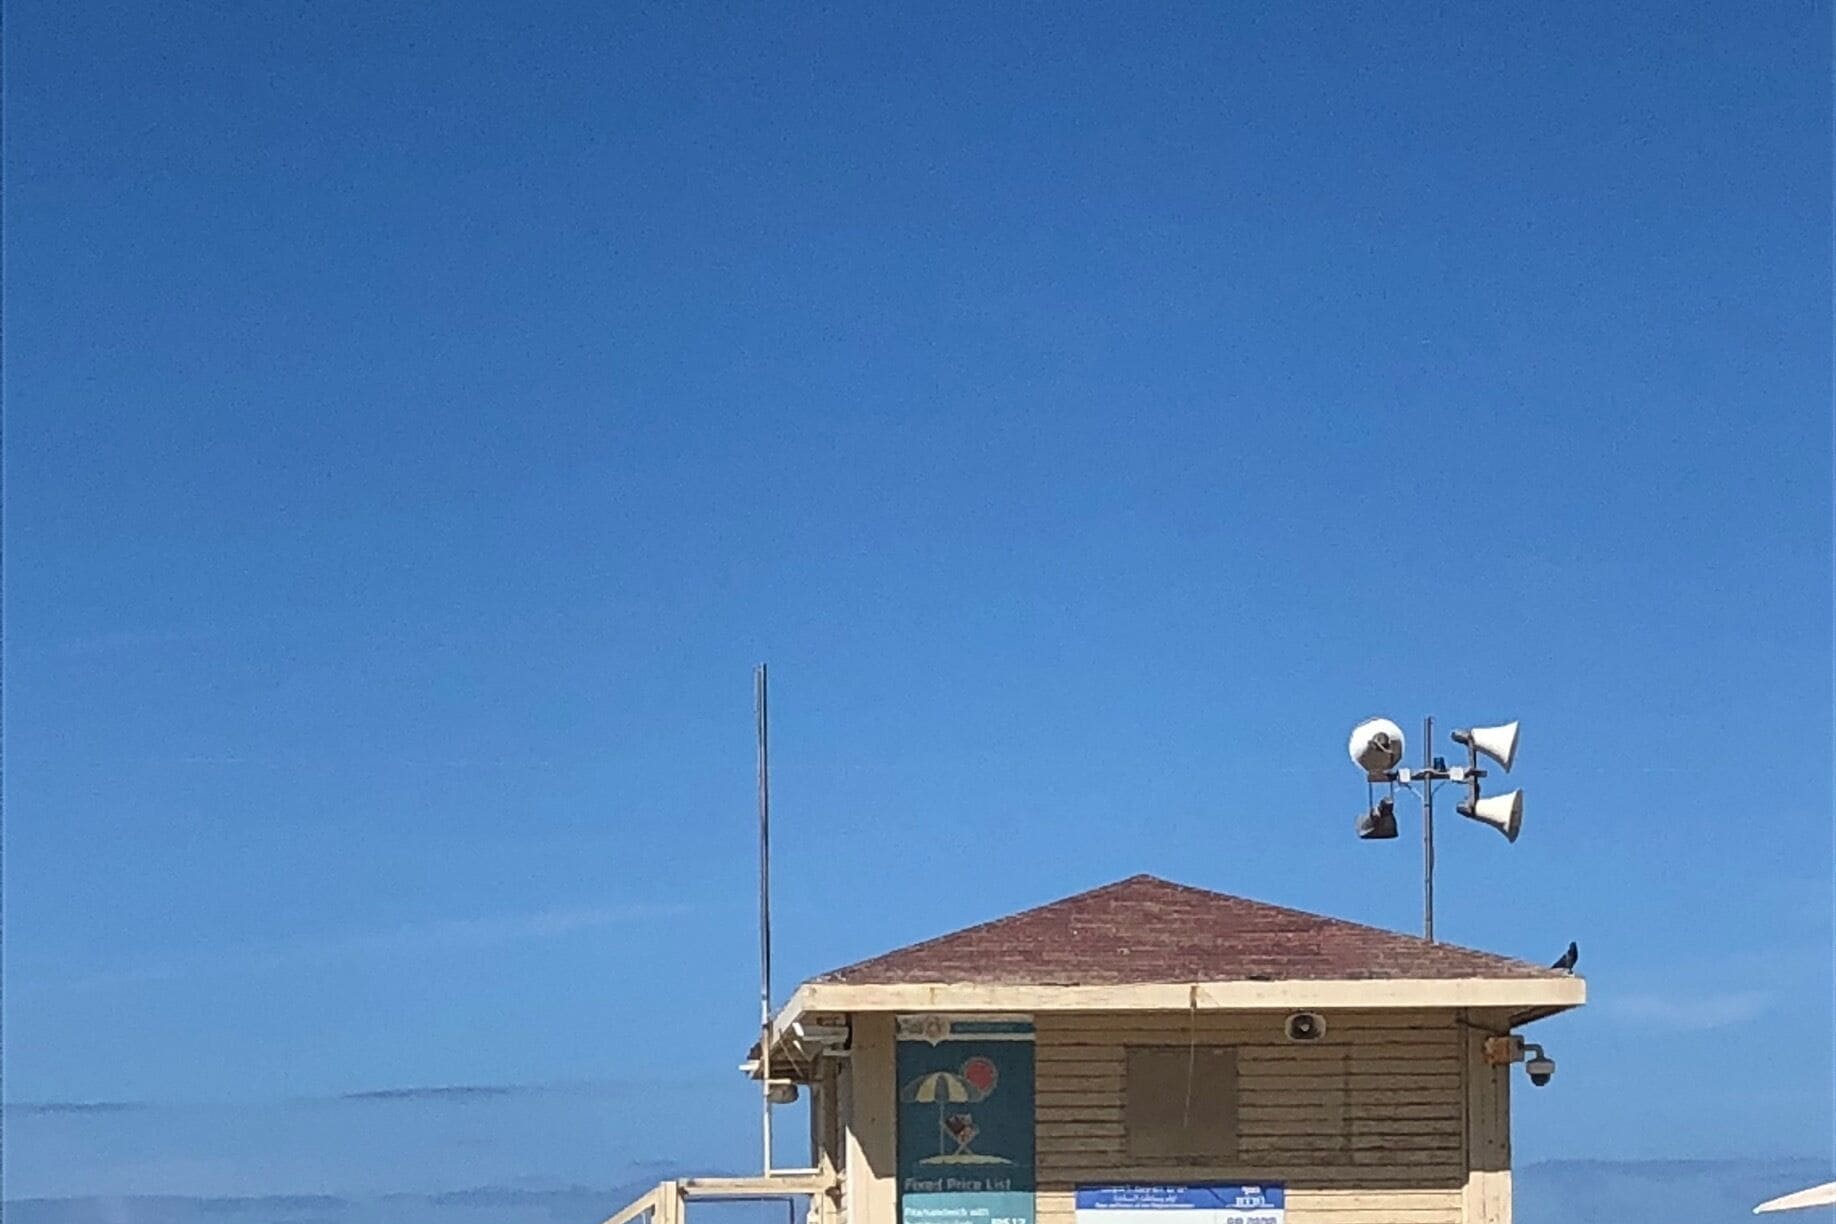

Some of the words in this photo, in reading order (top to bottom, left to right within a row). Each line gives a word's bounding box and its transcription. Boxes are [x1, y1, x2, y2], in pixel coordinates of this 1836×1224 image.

[904, 1178, 943, 1191] Fixed
[946, 1178, 982, 1191] Price
[986, 1178, 1011, 1191] List
